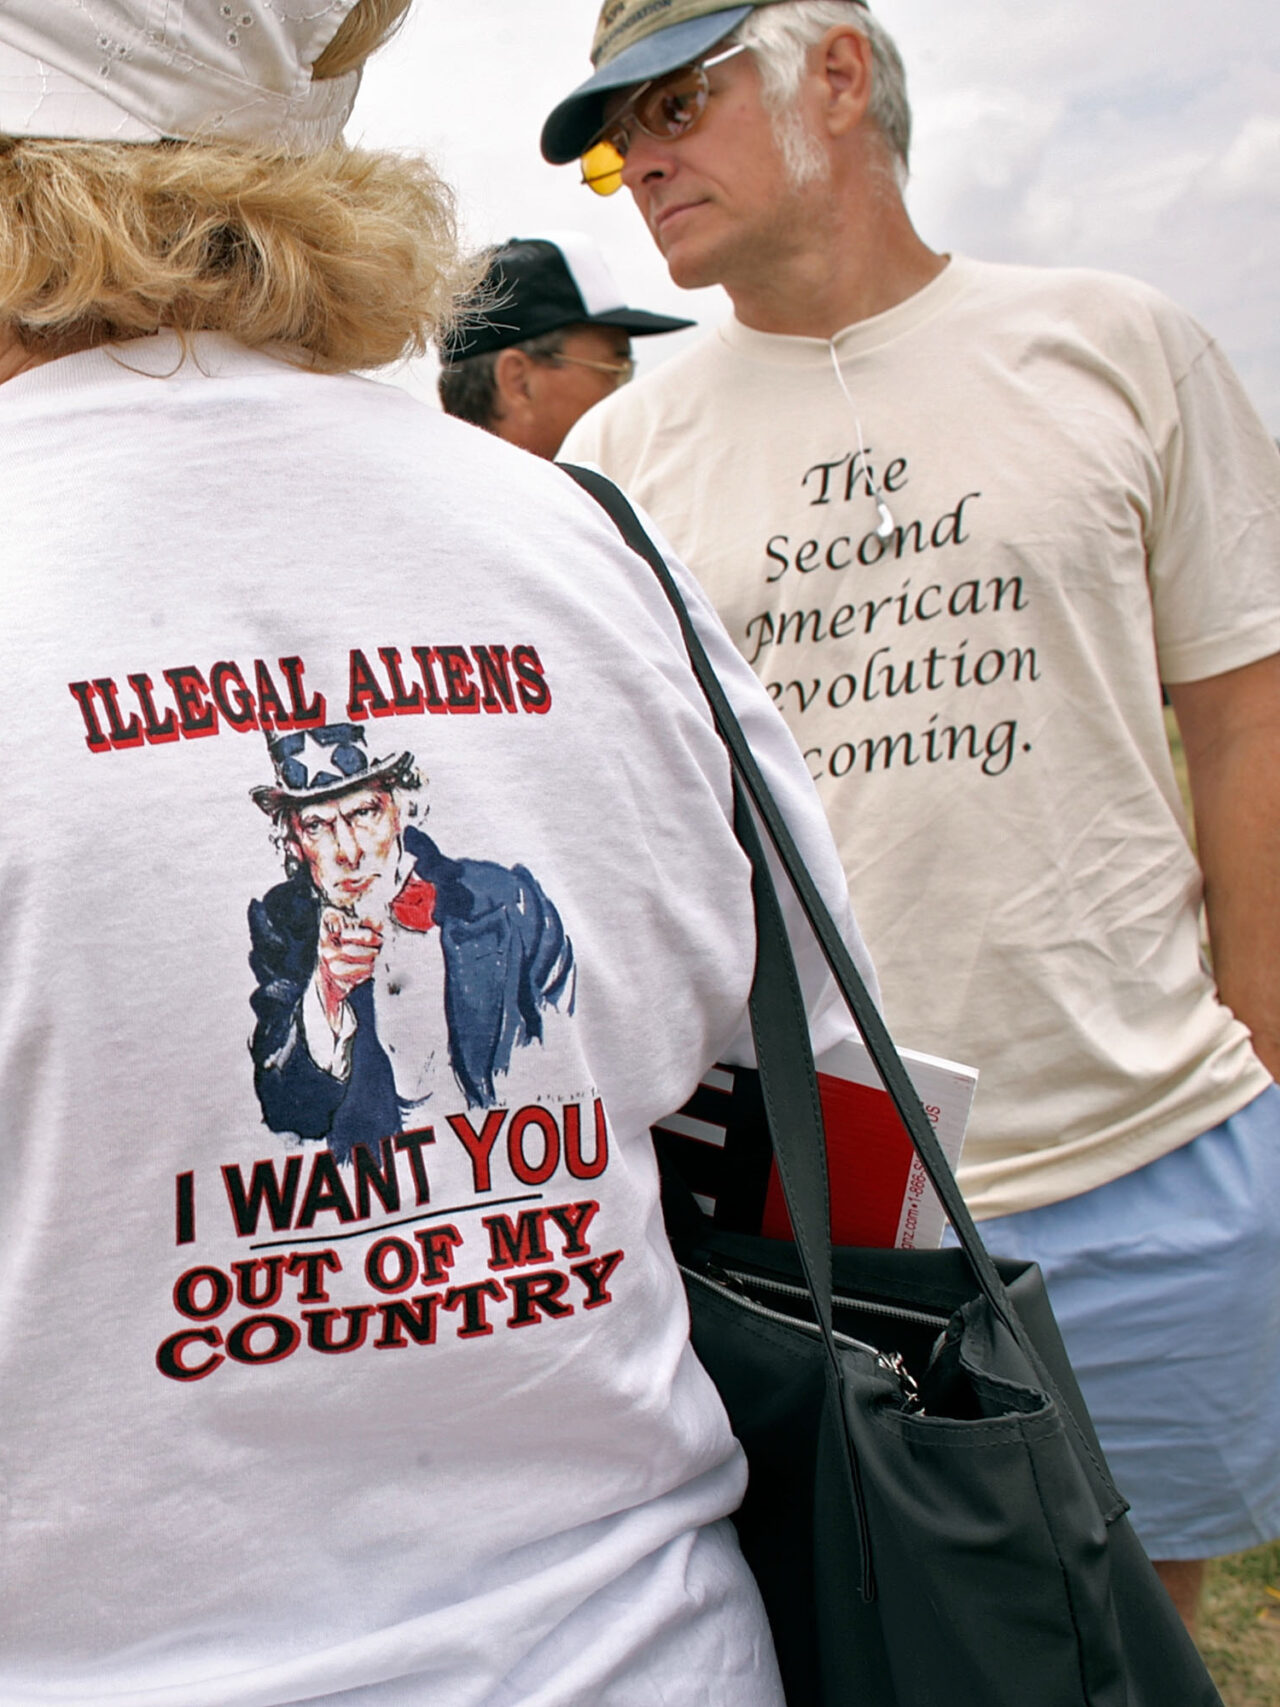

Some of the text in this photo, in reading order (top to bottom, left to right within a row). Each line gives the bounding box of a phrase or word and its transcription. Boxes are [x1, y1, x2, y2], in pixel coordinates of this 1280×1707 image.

[800, 448, 909, 506] The
[765, 492, 982, 584] Second
[745, 574, 1029, 666] American
[69, 645, 552, 753] ILLEGAL ALIENS
[803, 713, 1033, 781] coming.
[176, 1170, 195, 1246] I
[220, 1125, 436, 1237] WANT
[446, 1098, 609, 1194] YOU
[172, 1200, 600, 1320] OUT OF MY
[155, 1250, 624, 1382] COUNTRY
